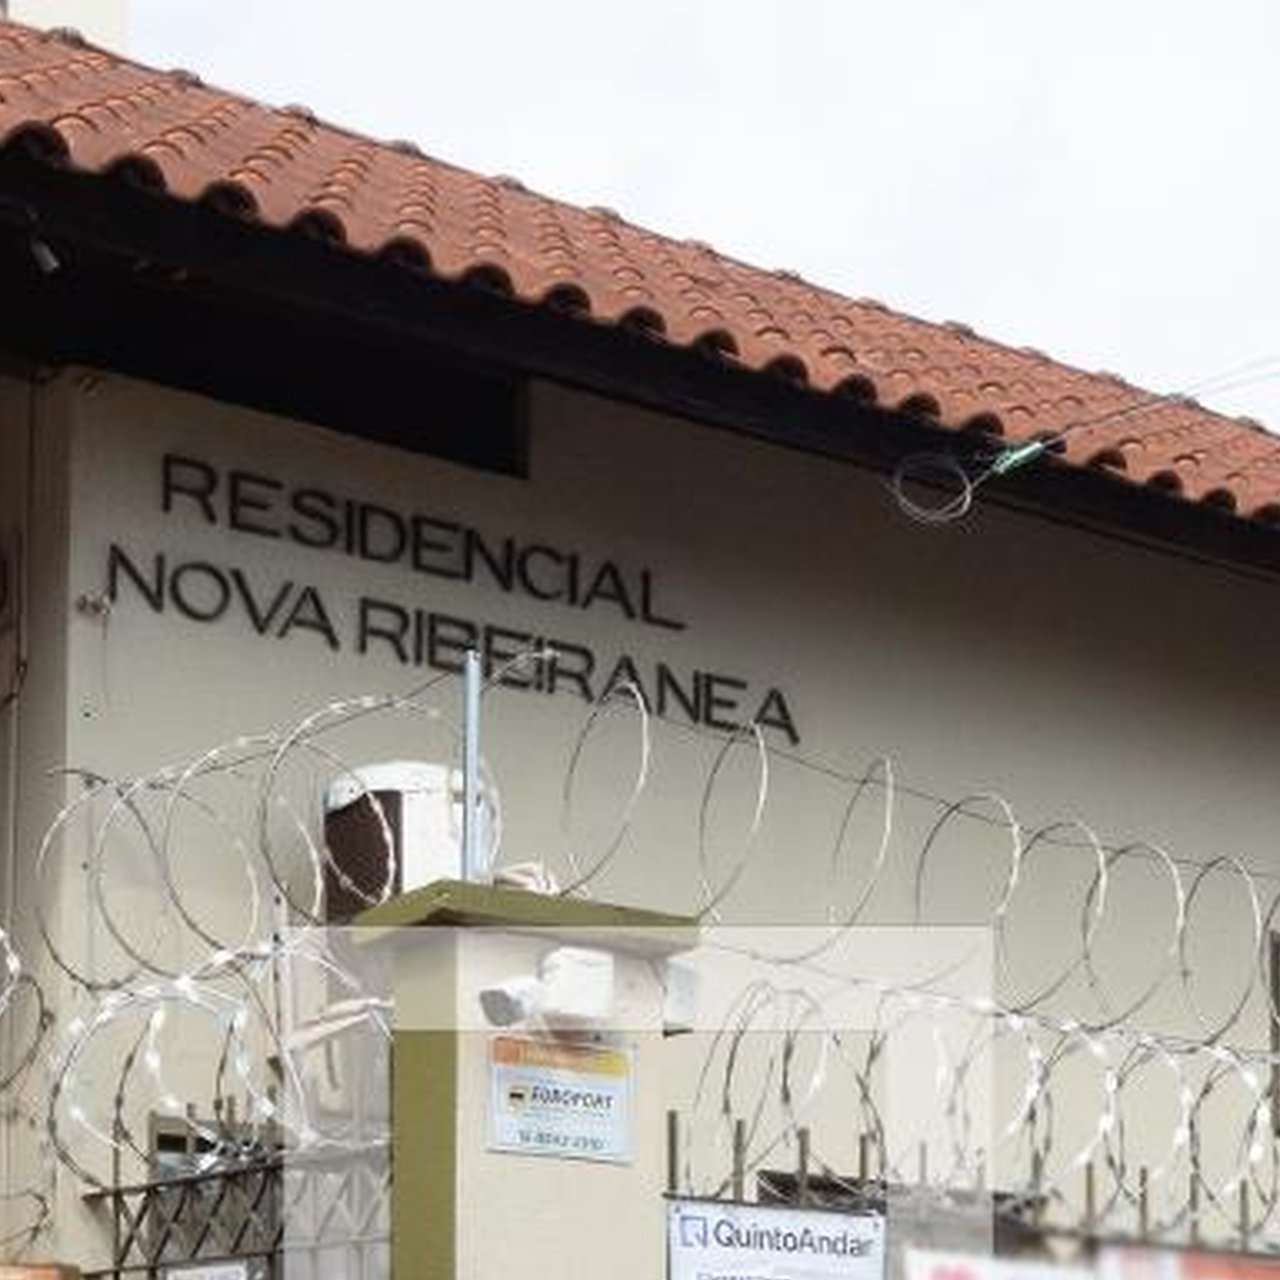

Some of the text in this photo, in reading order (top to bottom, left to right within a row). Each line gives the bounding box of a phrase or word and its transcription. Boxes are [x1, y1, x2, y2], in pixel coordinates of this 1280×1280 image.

[162, 452, 687, 631] RESIDENCIAL
[109, 543, 801, 747] NOVA RIBEIRANEA
[713, 1219, 875, 1258] QuintoAndar
